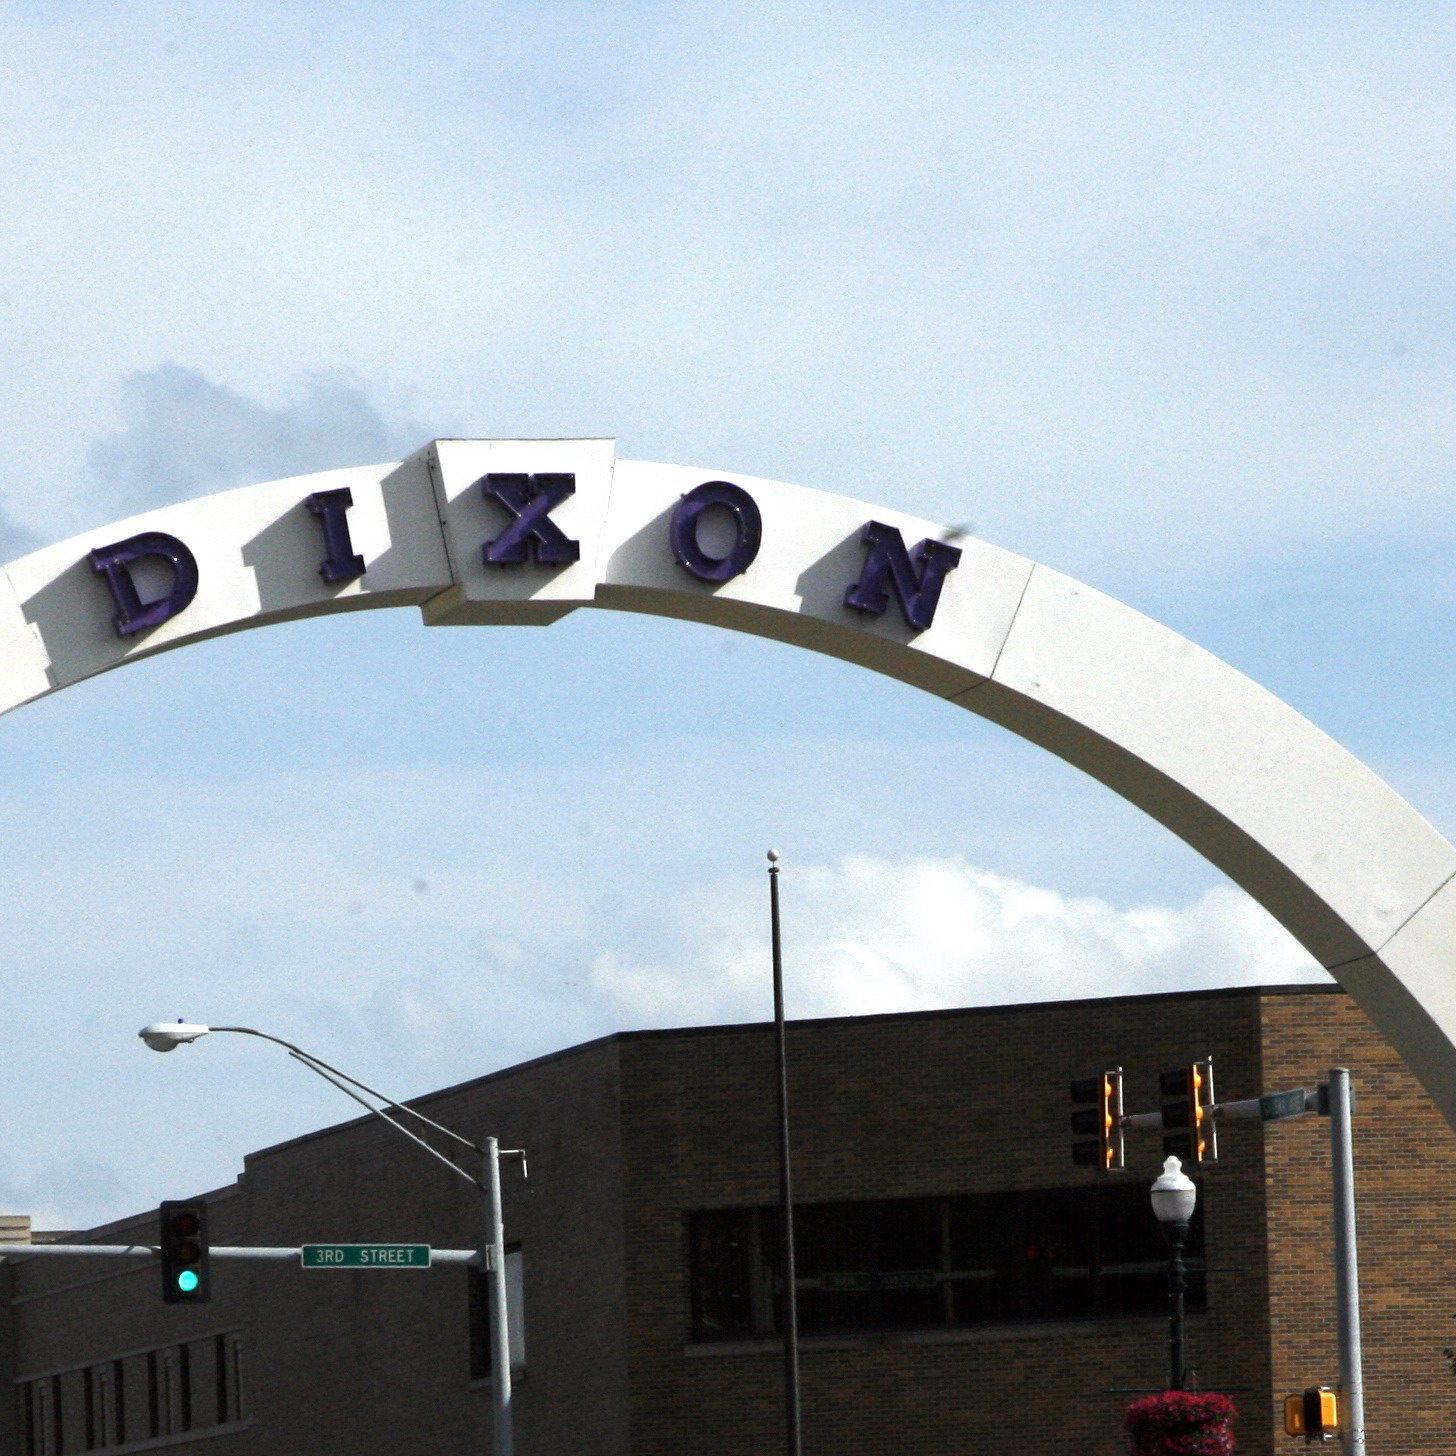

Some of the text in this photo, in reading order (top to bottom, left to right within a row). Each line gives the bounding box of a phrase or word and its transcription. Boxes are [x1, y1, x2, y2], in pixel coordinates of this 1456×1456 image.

[89, 472, 962, 638] DIXON
[316, 1249, 414, 1263] 3RD STREET
